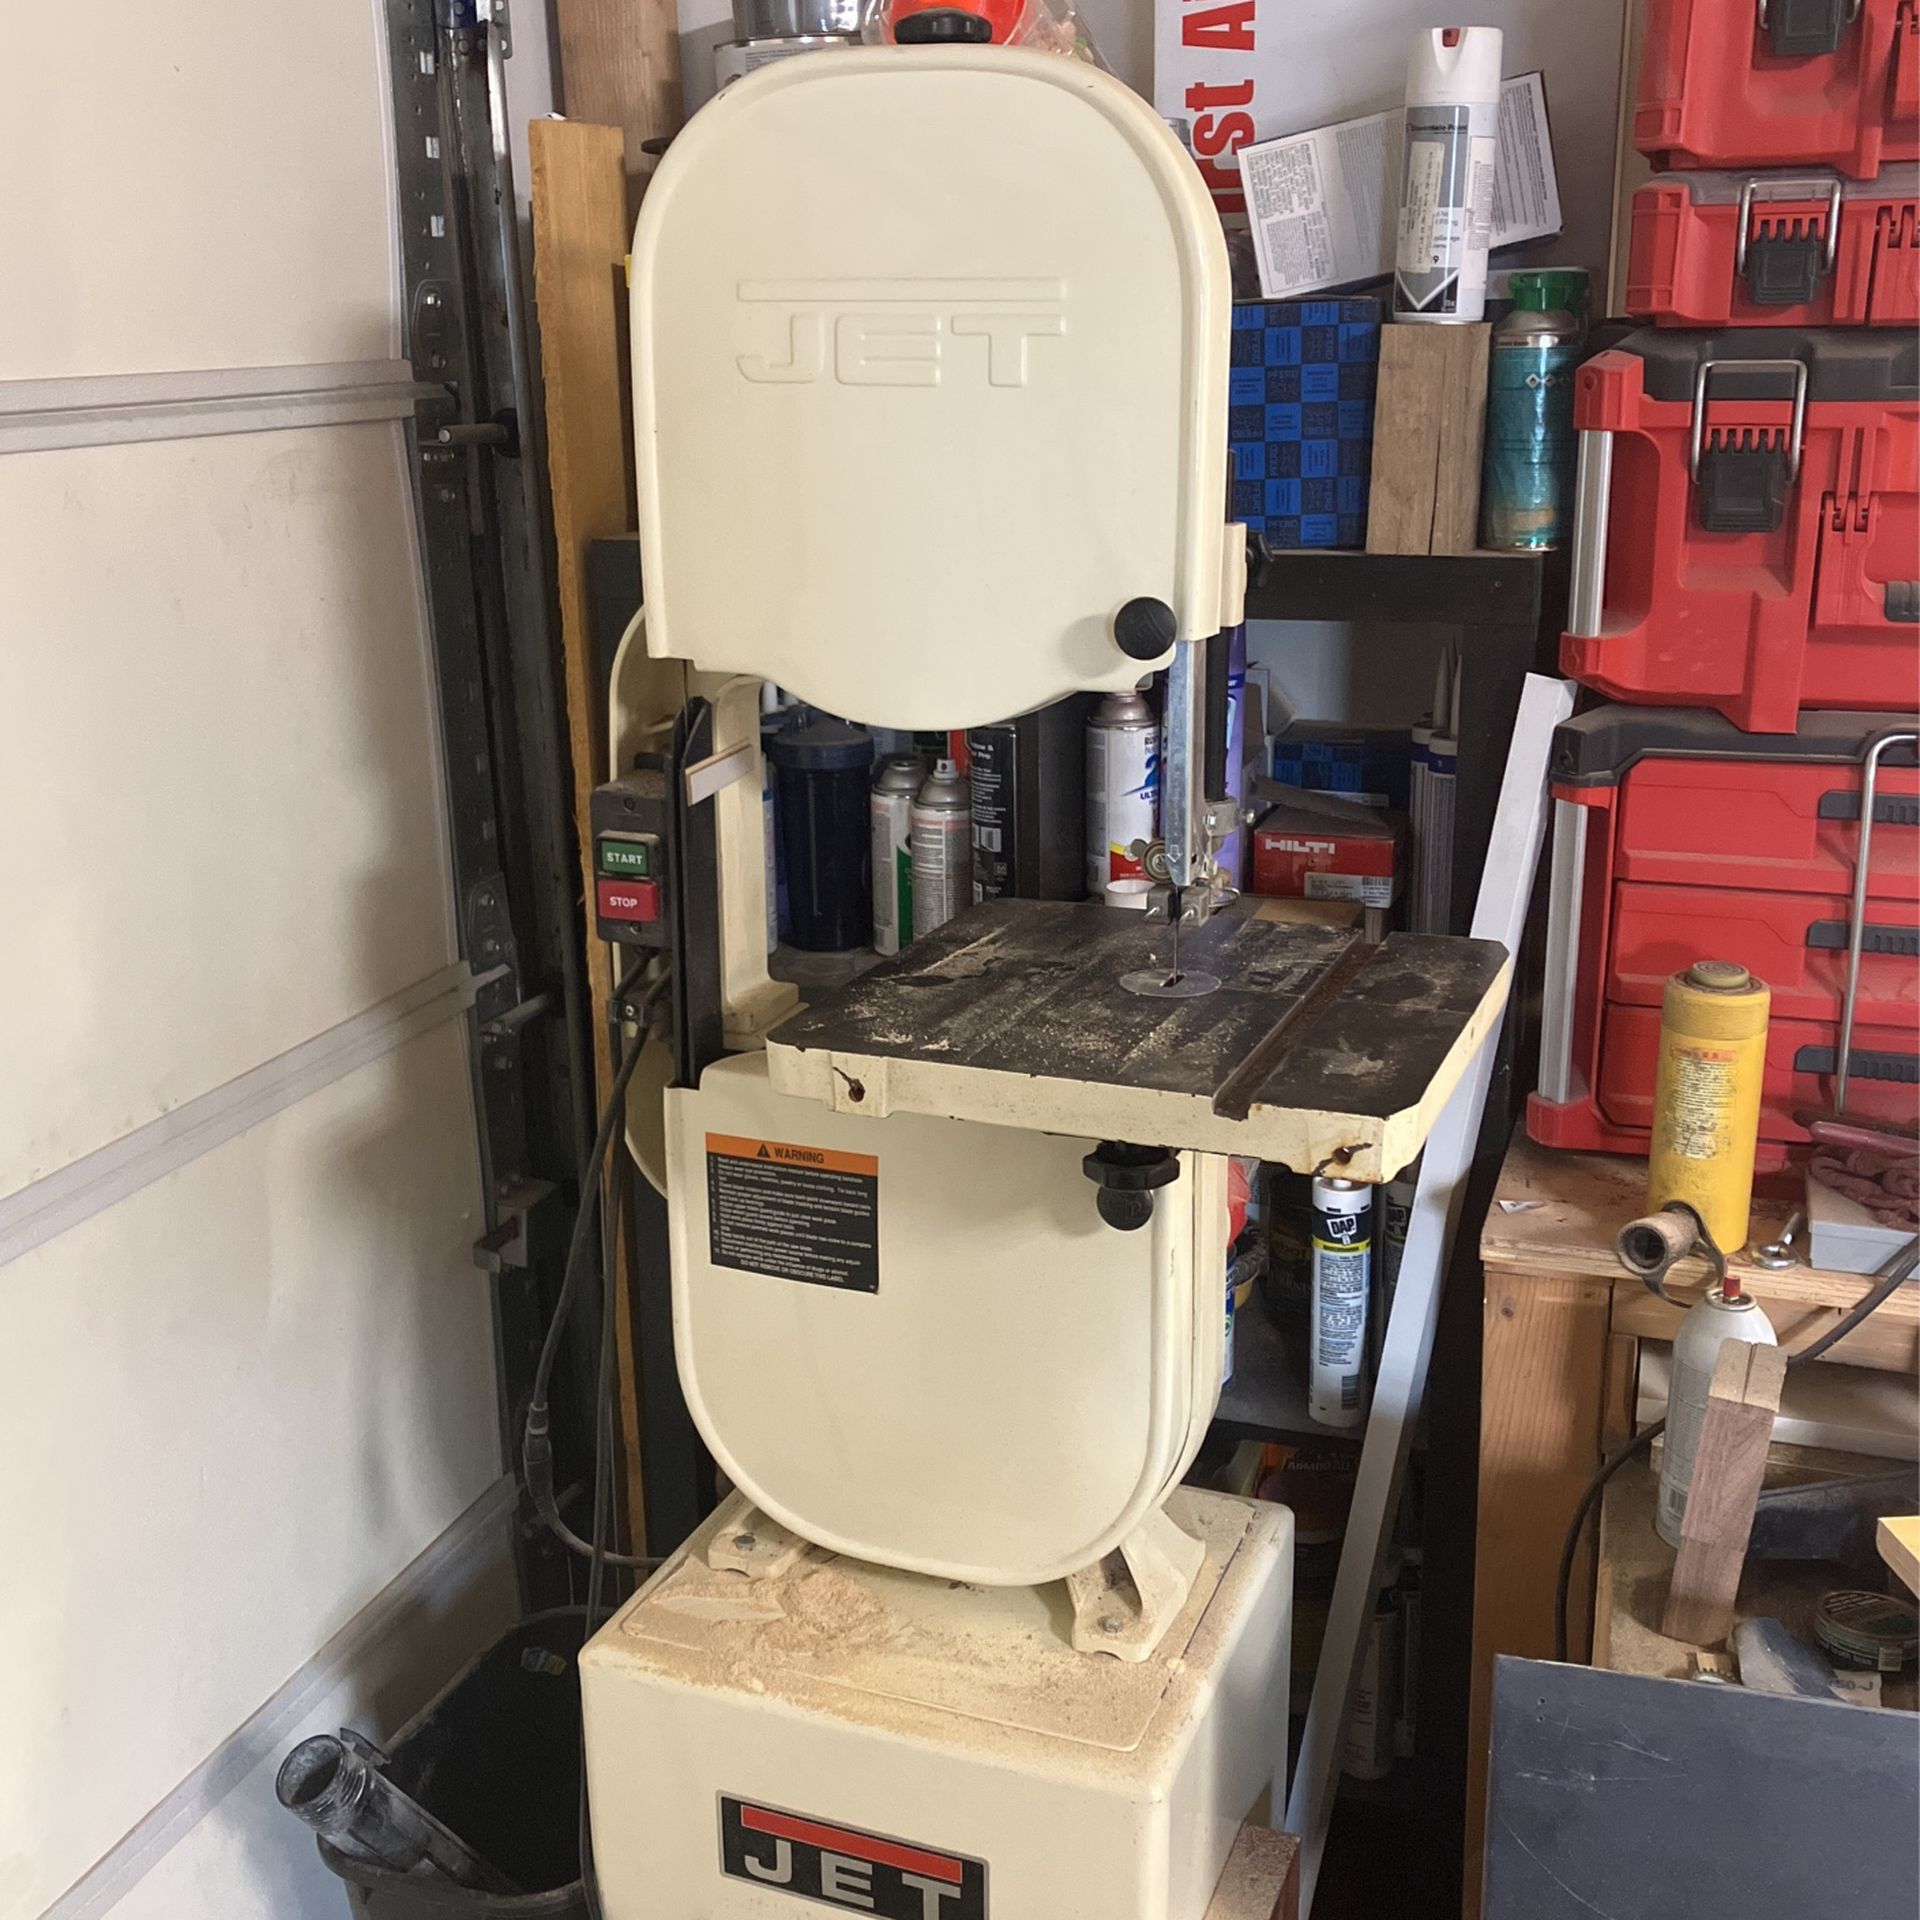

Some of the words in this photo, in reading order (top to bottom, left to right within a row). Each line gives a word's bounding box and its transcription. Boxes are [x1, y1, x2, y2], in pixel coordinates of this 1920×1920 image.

[736, 313, 1067, 388] JET
[1265, 838, 1336, 855] HILTI
[606, 851, 643, 866] START
[610, 896, 638, 908] STOP
[774, 1146, 825, 1165] WARNING
[743, 1838, 962, 1920] JET
